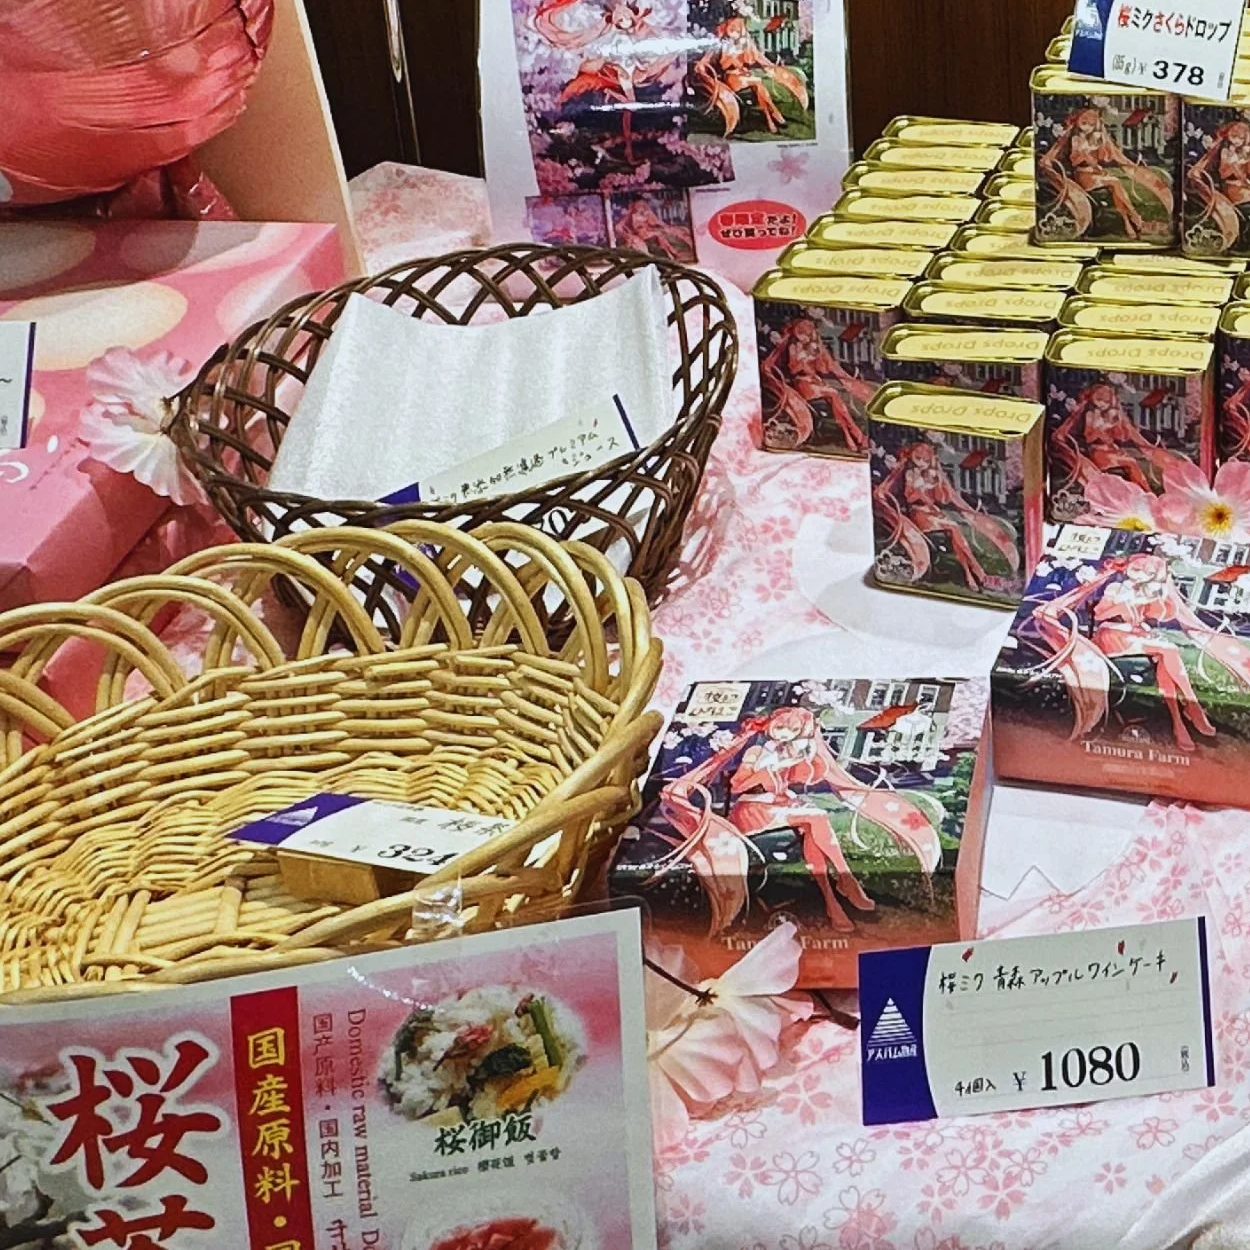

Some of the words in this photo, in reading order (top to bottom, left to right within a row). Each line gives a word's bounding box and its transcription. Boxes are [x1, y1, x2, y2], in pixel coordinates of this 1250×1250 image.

[1117, 3, 1232, 44] 桜ミクさくらドロップ
[1152, 59, 1206, 86] 378
[1087, 349, 1142, 361] Drops
[1147, 349, 1205, 361] Drops
[910, 403, 967, 417] Drops
[974, 405, 1034, 423] Drops
[1081, 740, 1145, 760] Tamura
[1148, 748, 1191, 768] Farm
[800, 936, 850, 950] Farm
[348, 1008, 370, 1099] Domestic
[1040, 1041, 1141, 1092] 1080
[352, 1104, 368, 1139] raw
[434, 1114, 537, 1156] 桜御飯
[355, 1144, 379, 1219] material
